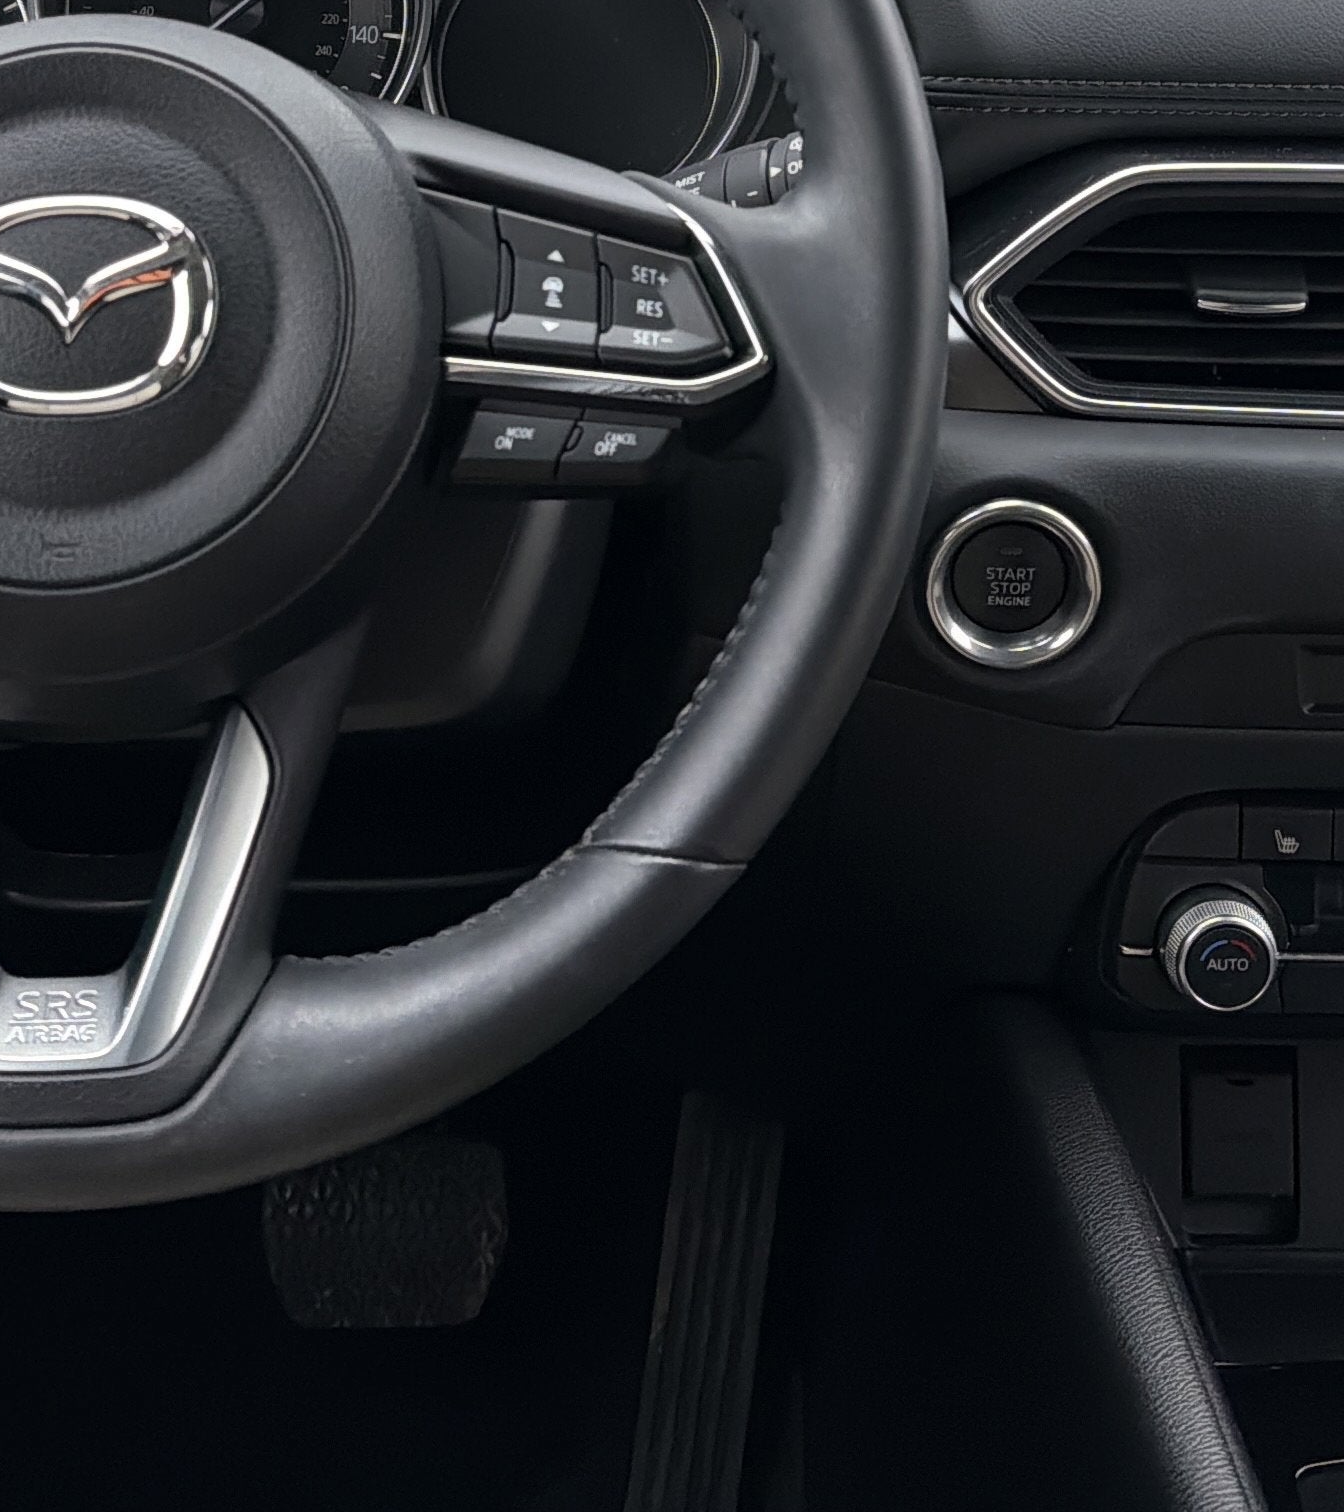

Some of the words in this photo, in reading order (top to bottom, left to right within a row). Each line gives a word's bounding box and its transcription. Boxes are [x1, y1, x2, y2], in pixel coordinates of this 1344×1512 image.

[321, 14, 340, 25] 220
[350, 24, 379, 45] 140
[314, 45, 334, 57] 240
[675, 171, 706, 189] MIST
[631, 264, 669, 286] SET+
[635, 298, 664, 319] RES
[505, 426, 536, 441] MODE
[604, 431, 637, 446] CANCEL
[494, 436, 514, 451] ON
[594, 440, 618, 456] OFF
[986, 566, 1036, 581] START
[990, 581, 1031, 595] STOP
[987, 595, 1031, 606] ENGINE
[1206, 957, 1249, 972] AUTO
[13, 989, 98, 1019] SRS
[3, 1023, 97, 1043] AIRBAG
